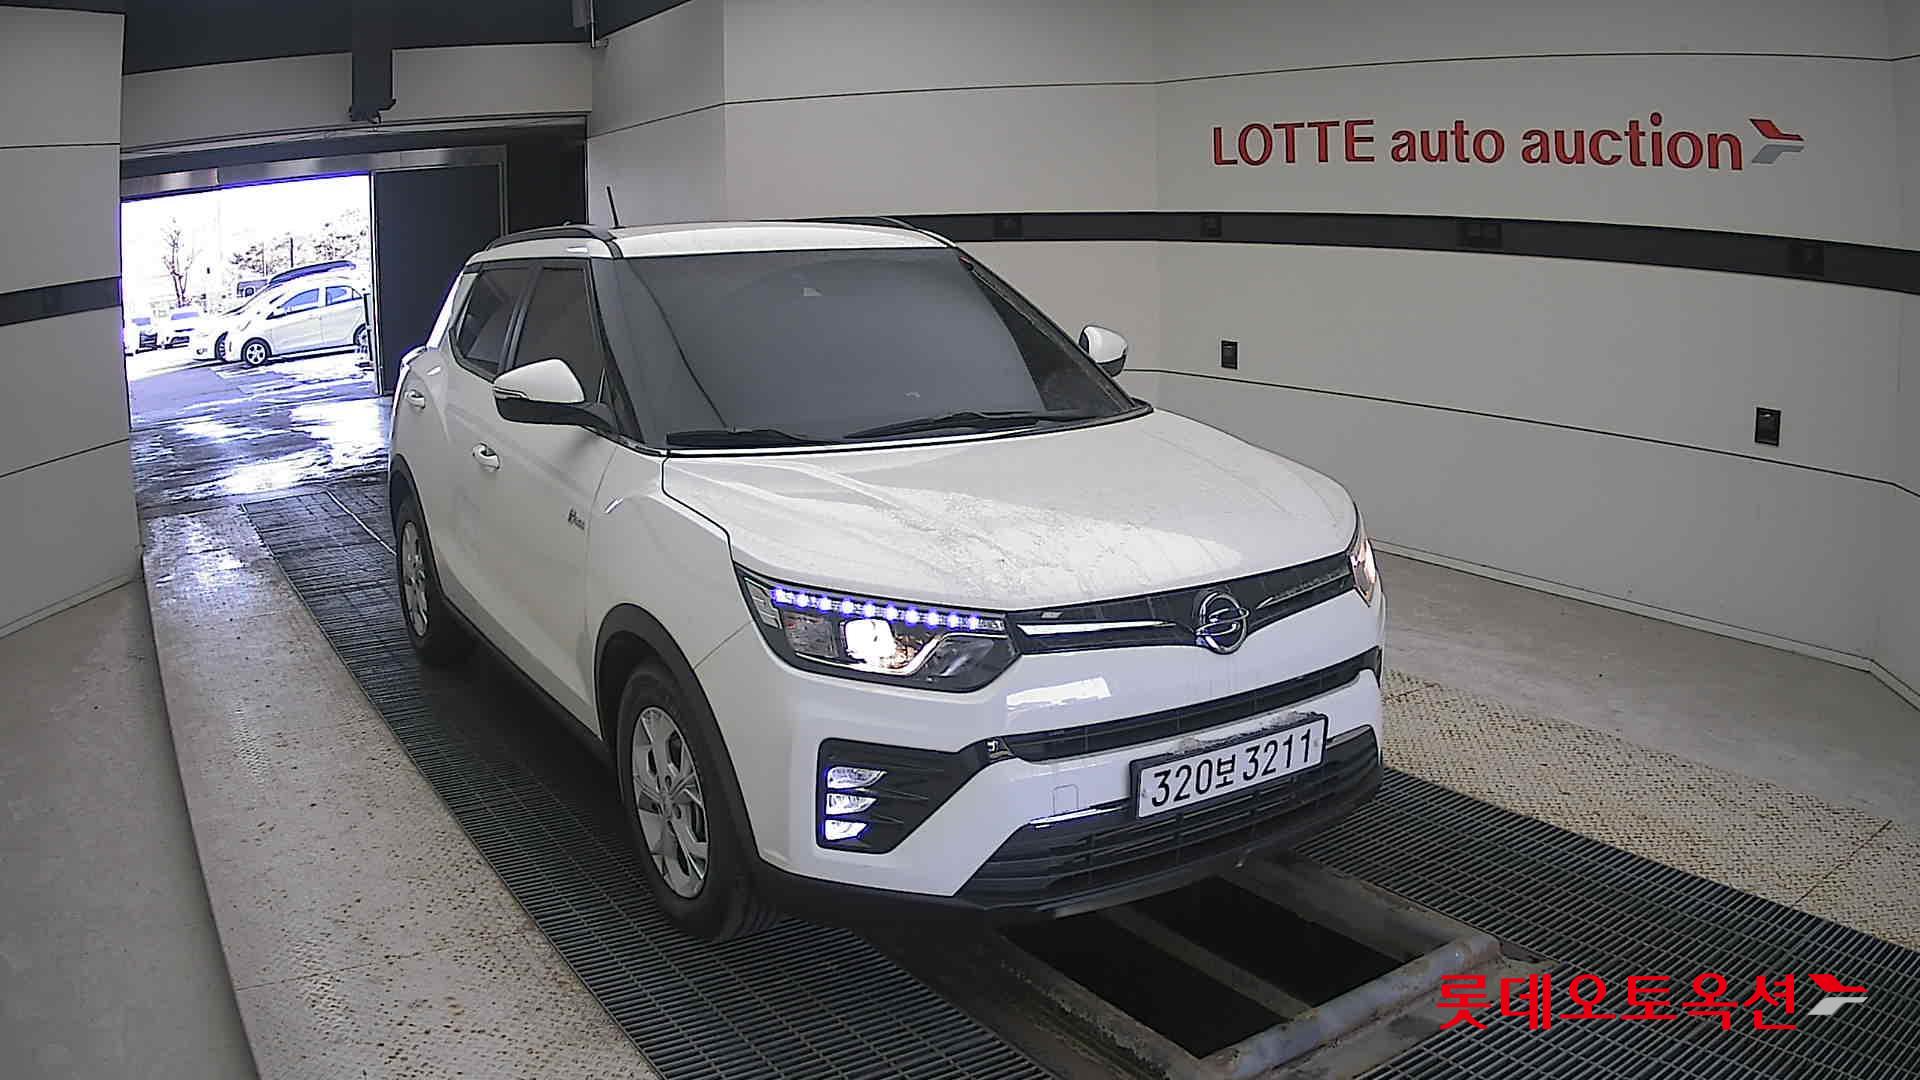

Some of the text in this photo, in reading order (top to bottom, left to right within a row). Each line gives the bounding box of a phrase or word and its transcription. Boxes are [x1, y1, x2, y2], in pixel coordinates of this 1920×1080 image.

[1212, 112, 1743, 170] LOTTE auto auction
